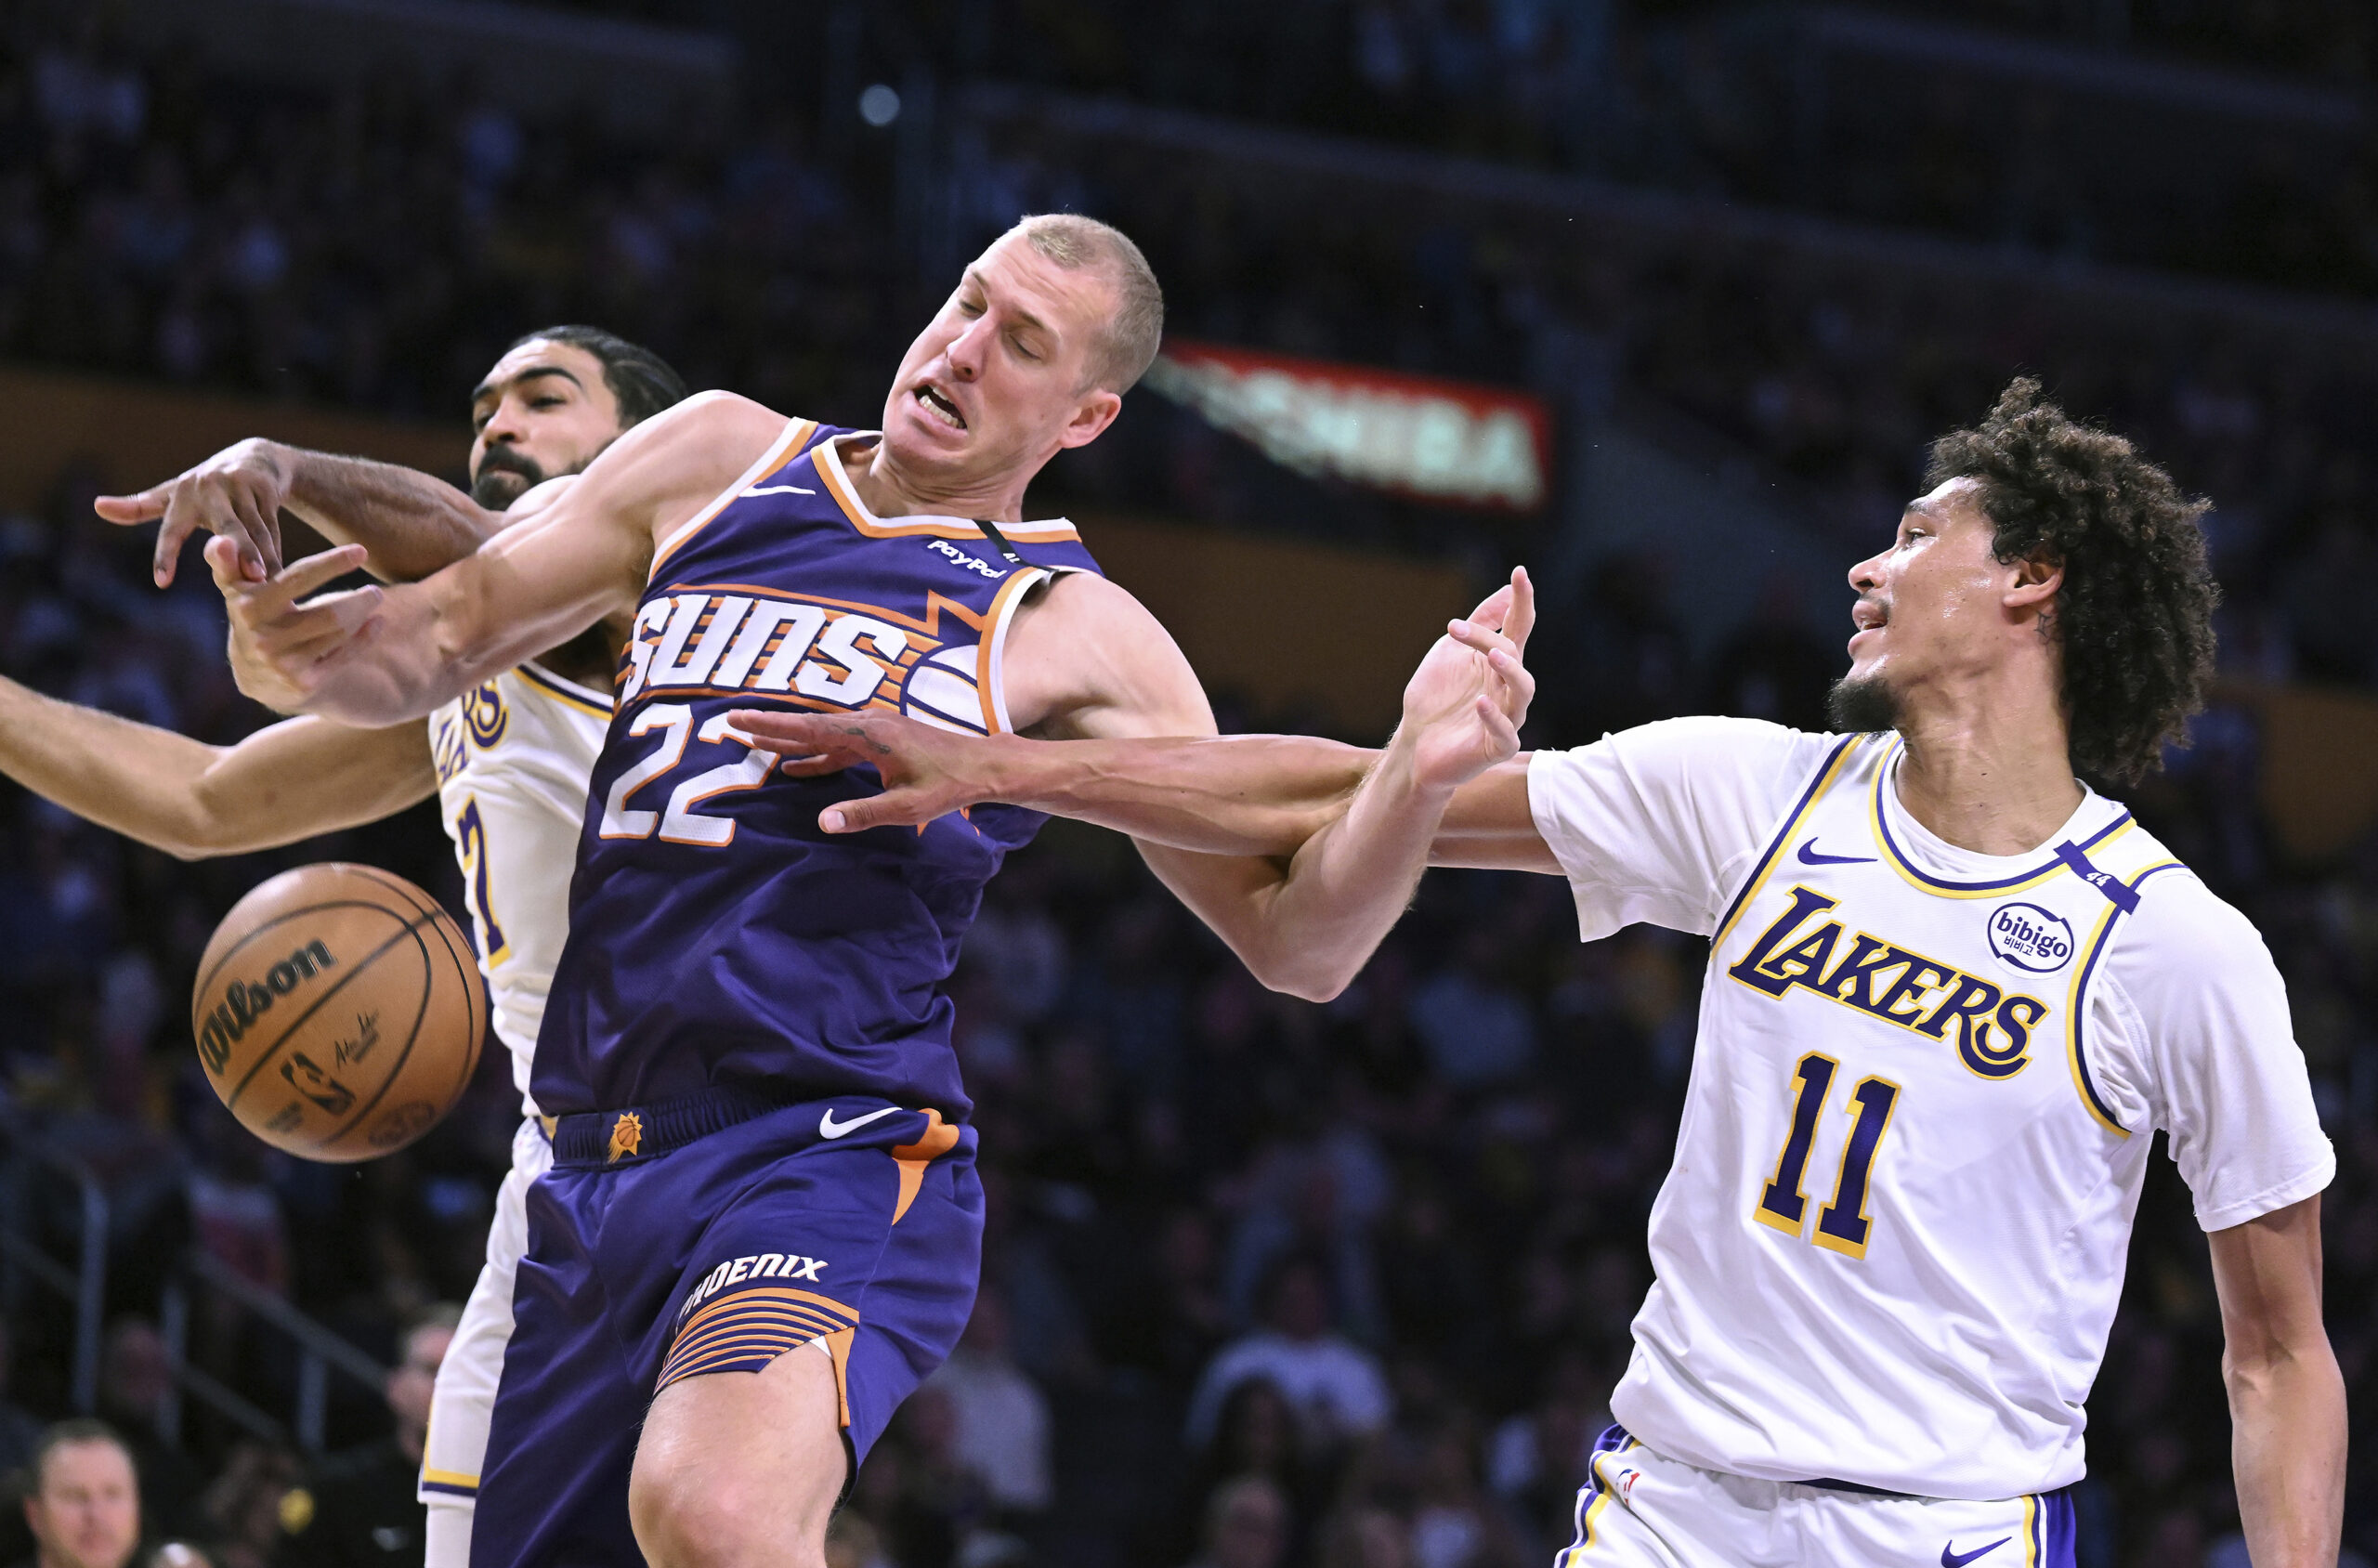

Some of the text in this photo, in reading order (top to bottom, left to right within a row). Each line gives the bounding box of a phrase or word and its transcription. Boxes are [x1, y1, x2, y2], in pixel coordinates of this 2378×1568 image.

[1146, 357, 1542, 507] SHIBA
[927, 540, 1008, 579] PayPal
[621, 593, 908, 706] SUNS
[599, 702, 781, 847] 22
[1996, 911, 2069, 958] bibigo
[2085, 871, 2112, 887] 44
[200, 938, 338, 1076] Wilson
[1728, 883, 2051, 1080] LAKERS
[1753, 1050, 1902, 1260] 11
[675, 1253, 829, 1337] HOENIX
